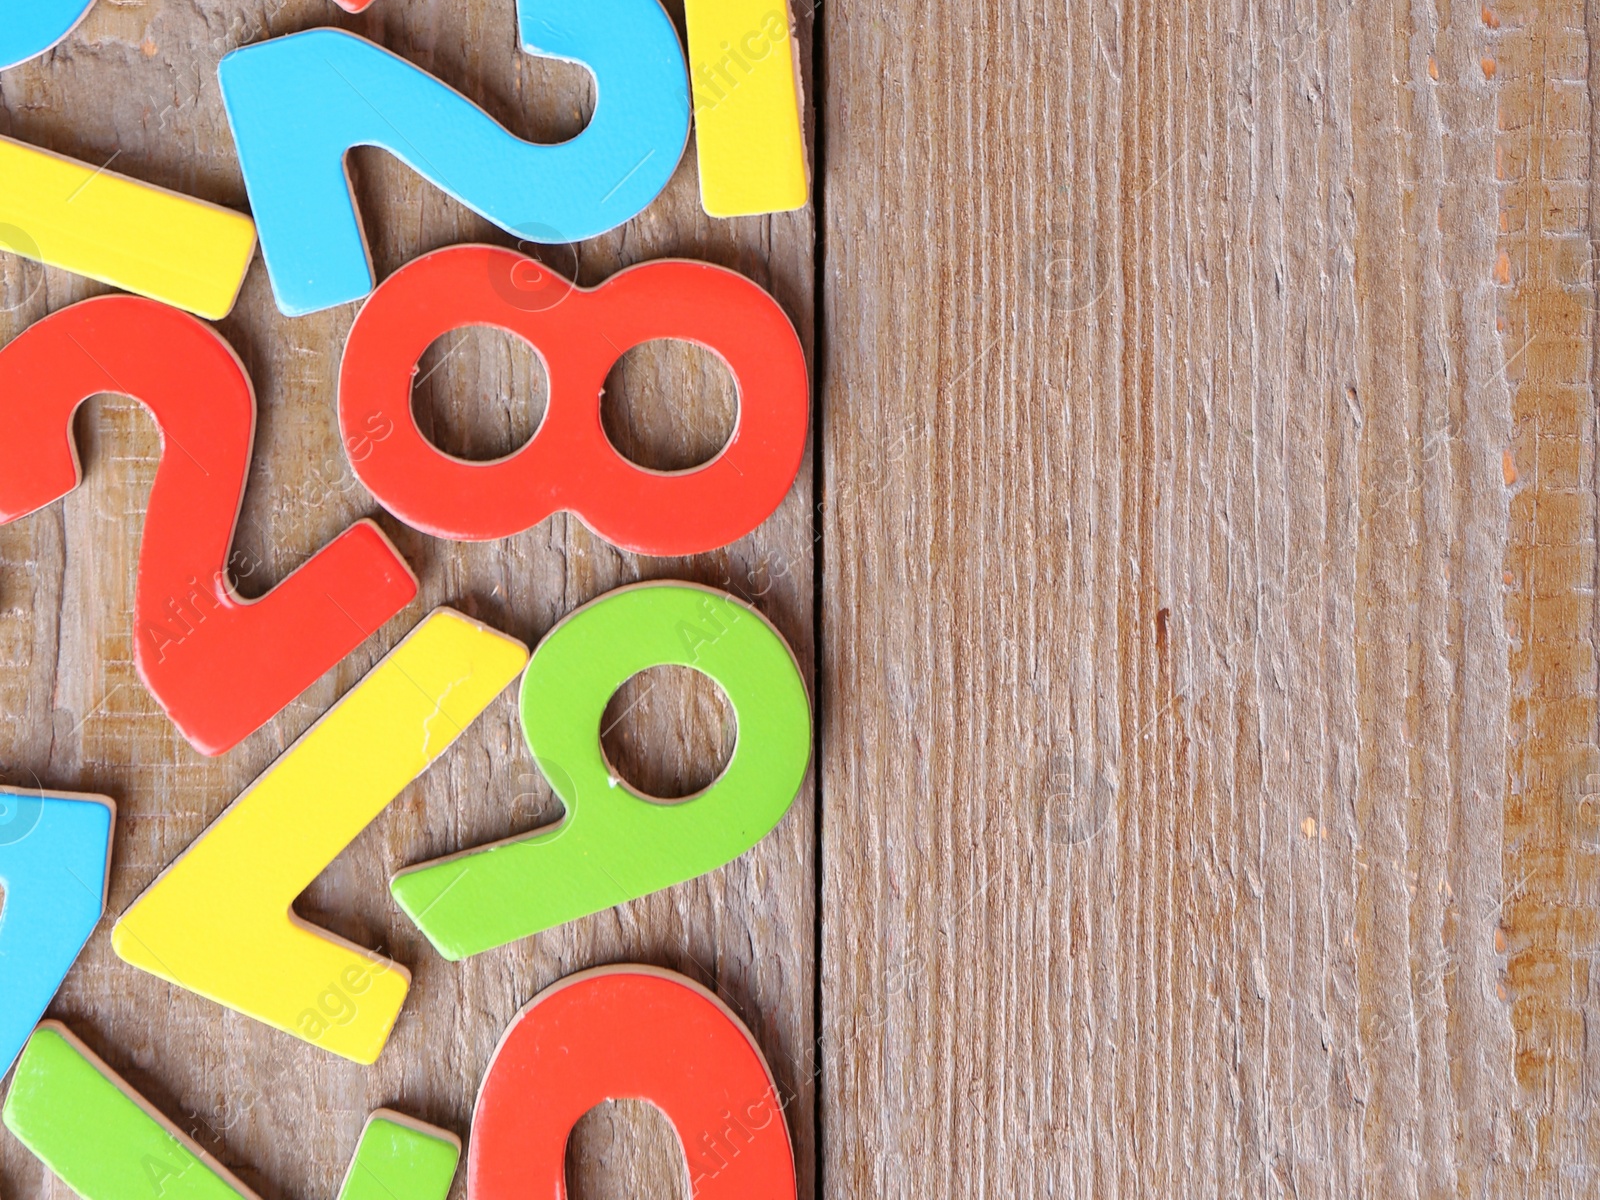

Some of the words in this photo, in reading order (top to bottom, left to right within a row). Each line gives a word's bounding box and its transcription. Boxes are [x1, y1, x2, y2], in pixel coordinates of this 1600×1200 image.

[0, 294, 418, 757] 2
[338, 243, 810, 558] 8
[110, 605, 530, 1067] 7
